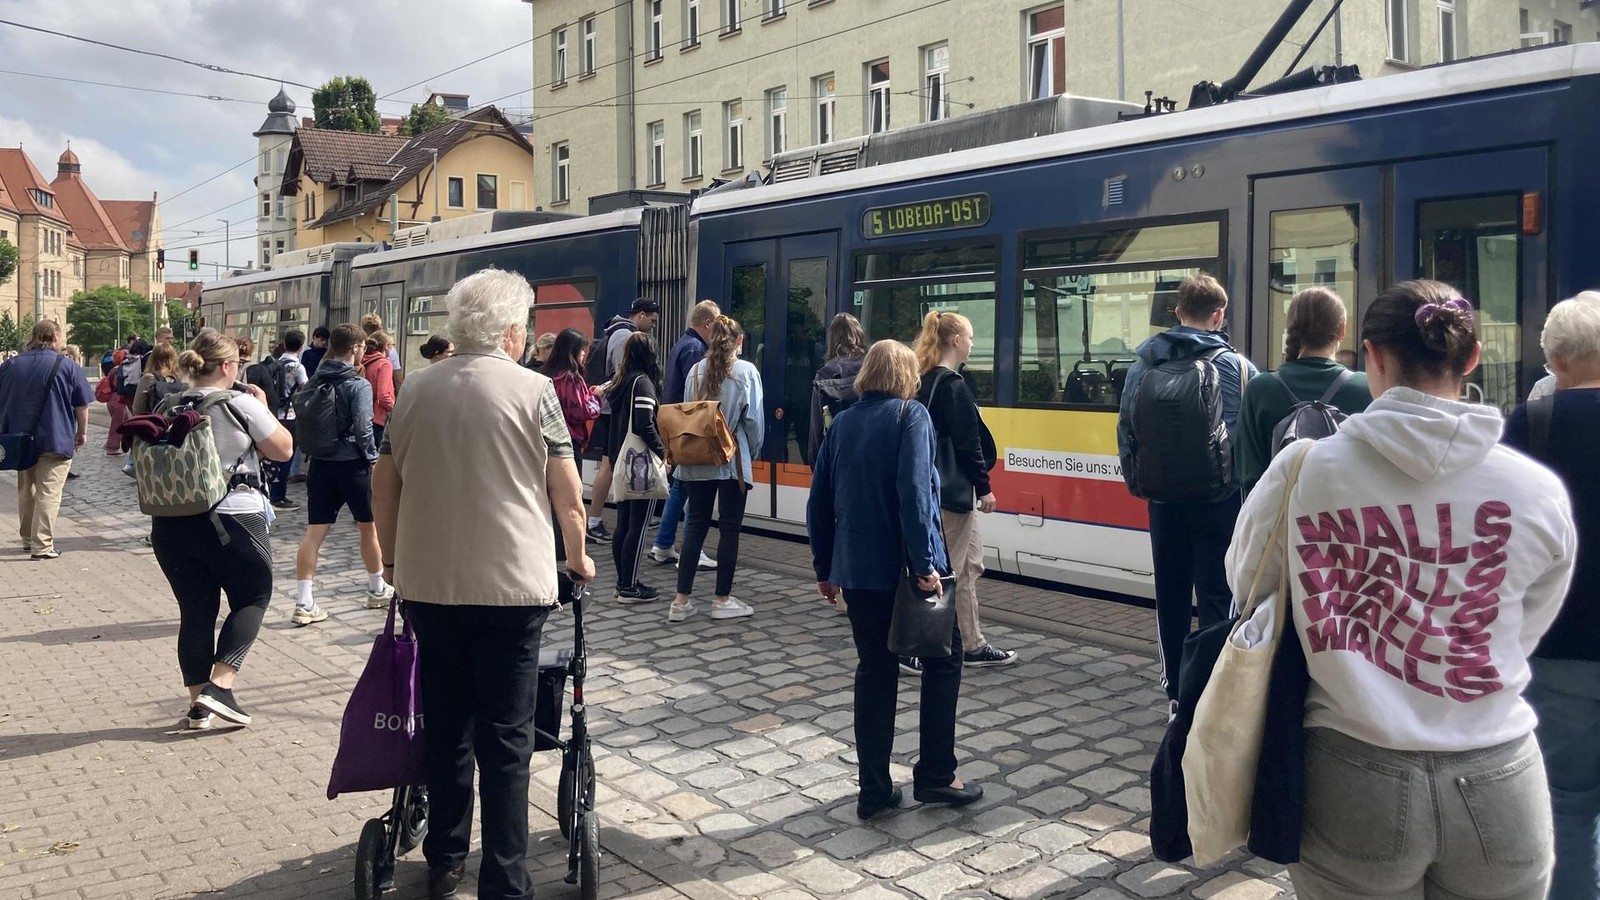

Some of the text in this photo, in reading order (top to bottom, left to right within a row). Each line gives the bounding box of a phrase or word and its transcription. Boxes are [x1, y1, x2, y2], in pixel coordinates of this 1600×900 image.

[873, 198, 981, 235] 5 LOBEDA-OST
[1008, 453, 1063, 471] Besuchen
[1065, 457, 1084, 472] Sie
[1086, 463, 1112, 475] uns:
[1296, 500, 1512, 565] WALLS
[1295, 543, 1508, 607] WALLS
[1297, 568, 1500, 637] WALLS
[1301, 591, 1492, 668] WALLS
[1305, 616, 1504, 703] WALLS
